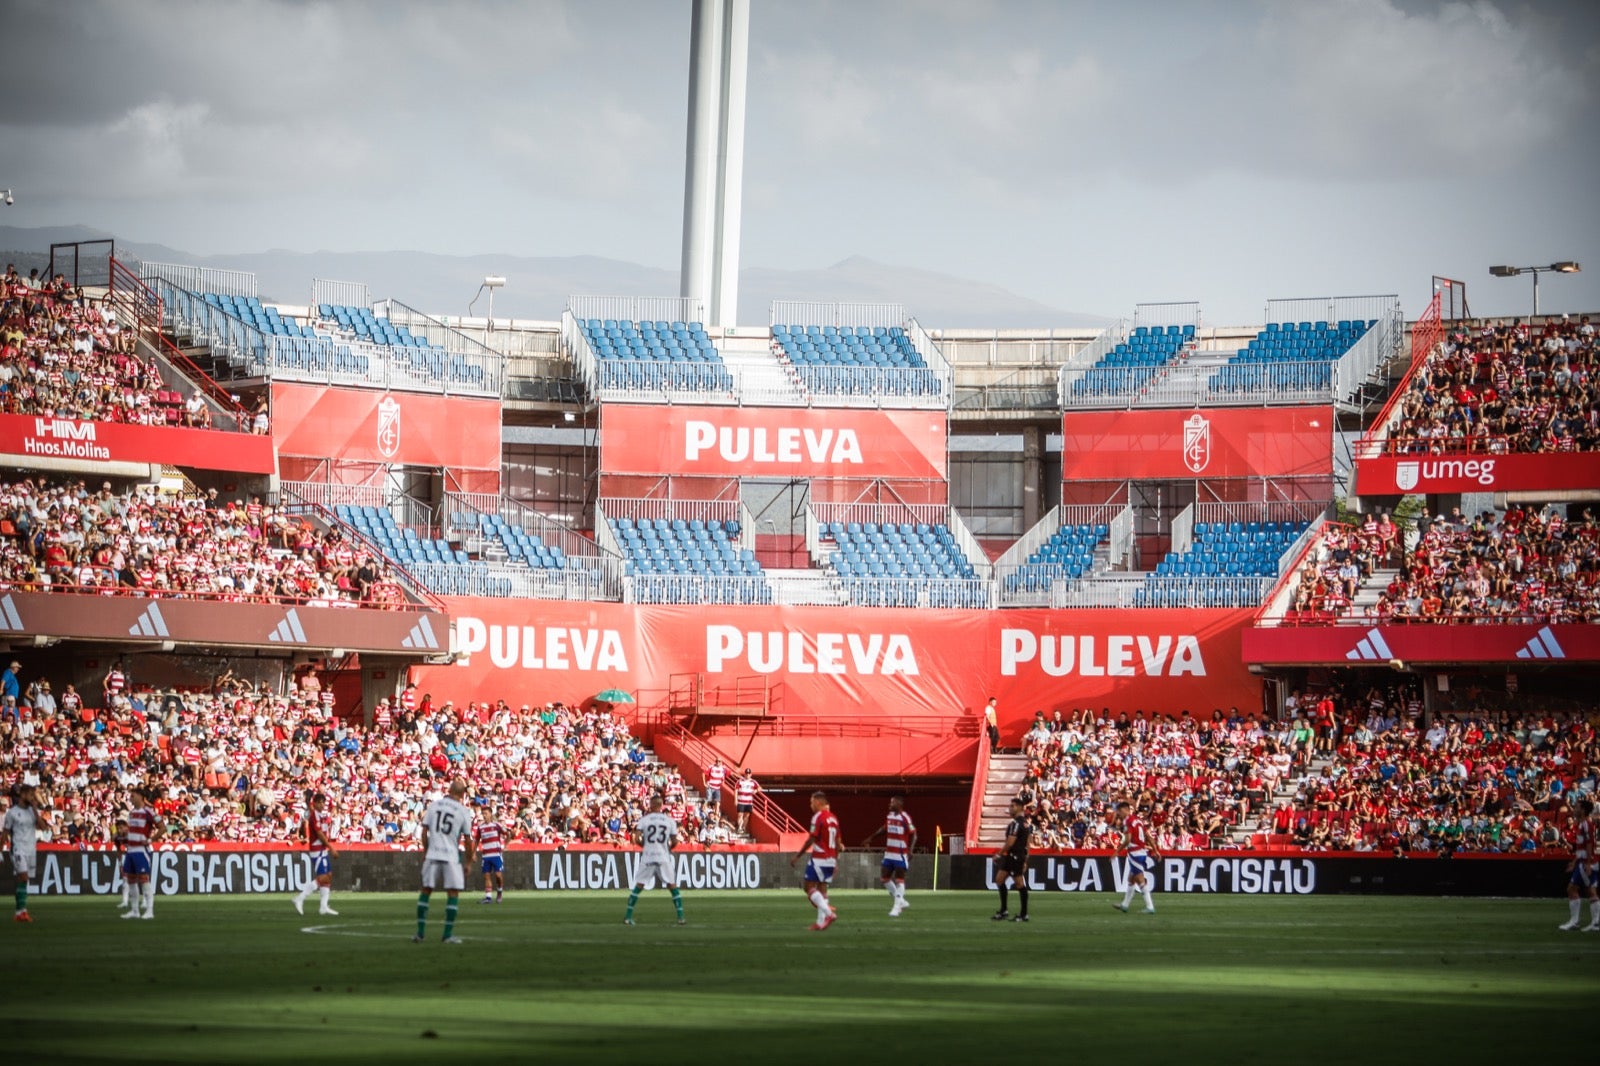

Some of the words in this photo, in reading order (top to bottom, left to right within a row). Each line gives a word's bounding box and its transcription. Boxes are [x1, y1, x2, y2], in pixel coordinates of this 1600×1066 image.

[24, 436, 111, 459] Hnos.Molina
[685, 421, 864, 465] PULEVA
[1422, 459, 1496, 485] umeg
[456, 616, 630, 672] PULEVA
[706, 624, 920, 676] PULEVA
[1001, 629, 1207, 677] PULEVA
[435, 810, 455, 836] 15
[647, 824, 668, 844] 23
[533, 853, 620, 889] LALIGA
